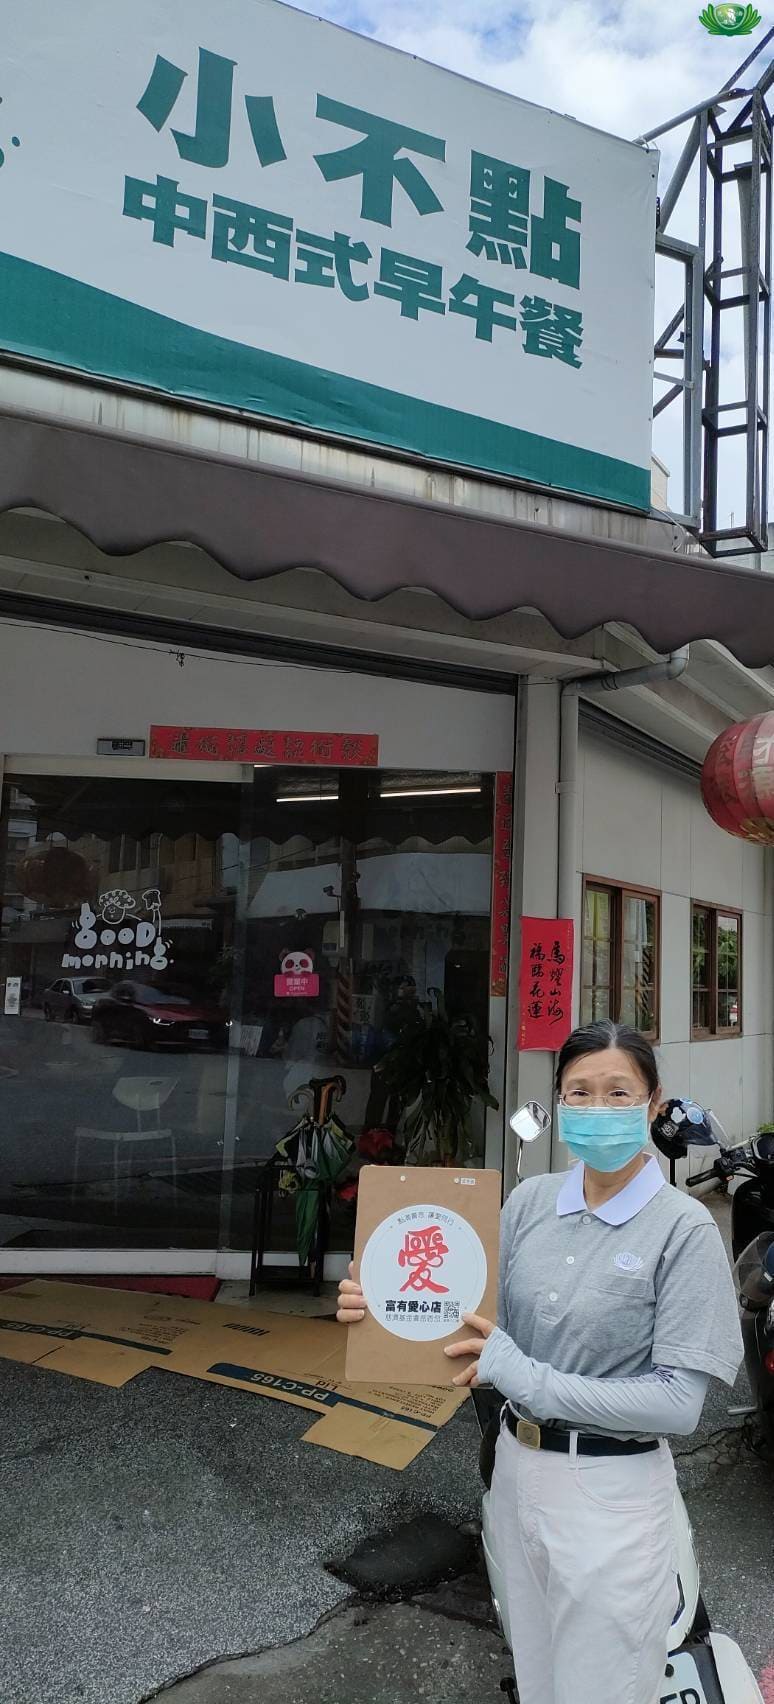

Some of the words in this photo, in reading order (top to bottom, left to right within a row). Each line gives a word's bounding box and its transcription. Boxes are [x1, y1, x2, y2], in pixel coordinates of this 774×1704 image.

[137, 47, 582, 289] 小不點
[124, 176, 583, 368] 中西式早午餐
[385, 1299, 442, 1314] 富有愛心店
[249, 1372, 331, 1401] PP-C165
